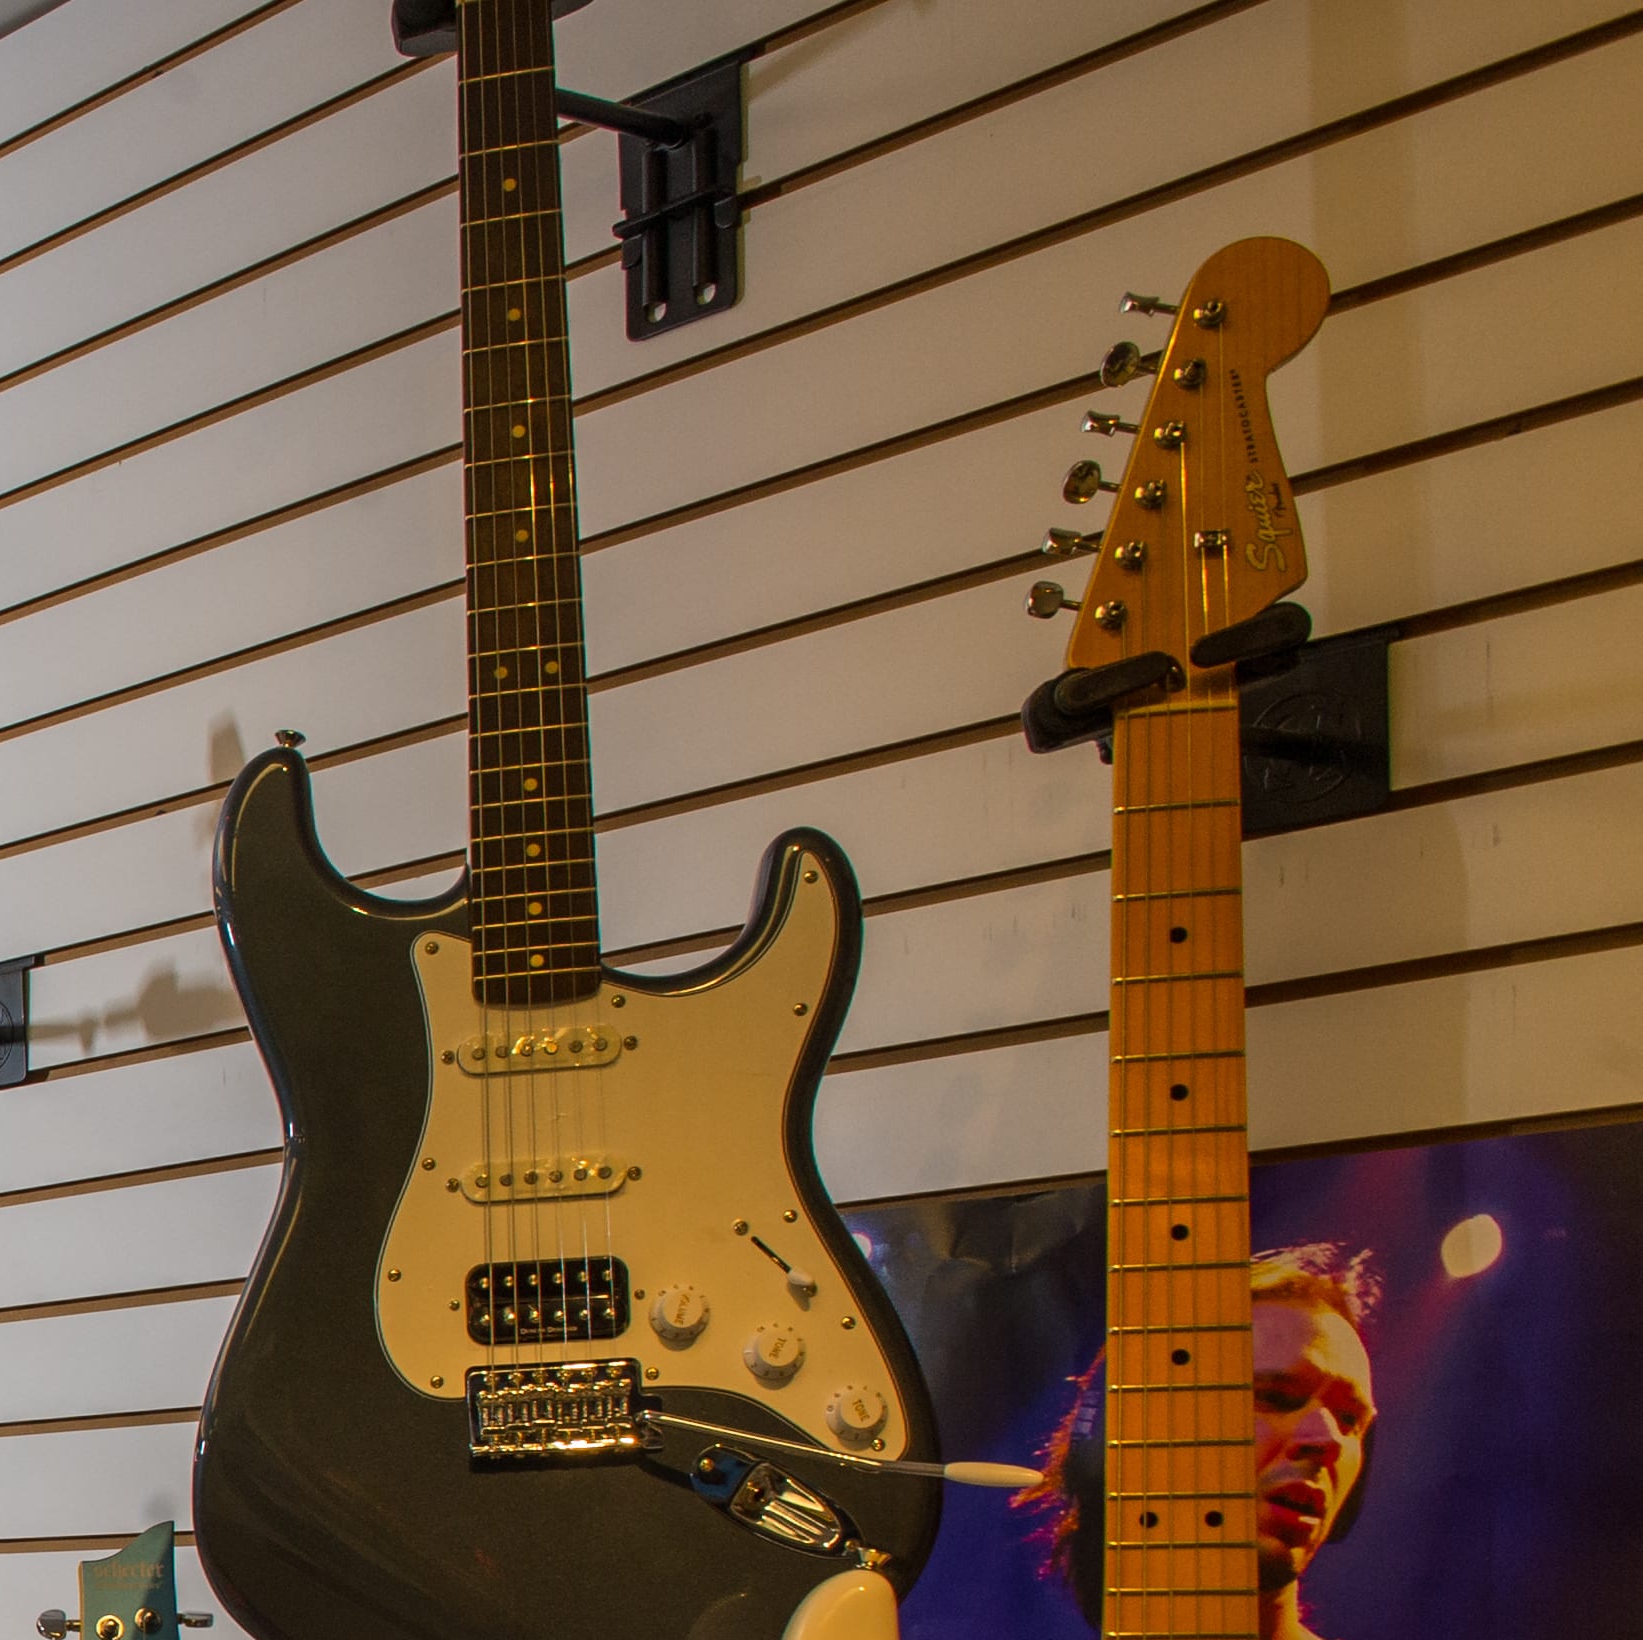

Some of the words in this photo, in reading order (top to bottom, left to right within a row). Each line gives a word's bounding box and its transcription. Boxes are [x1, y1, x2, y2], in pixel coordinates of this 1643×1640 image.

[1245, 469, 1293, 572] Squier
[769, 1337, 787, 1360] TONE
[852, 1398, 871, 1422] TONE
